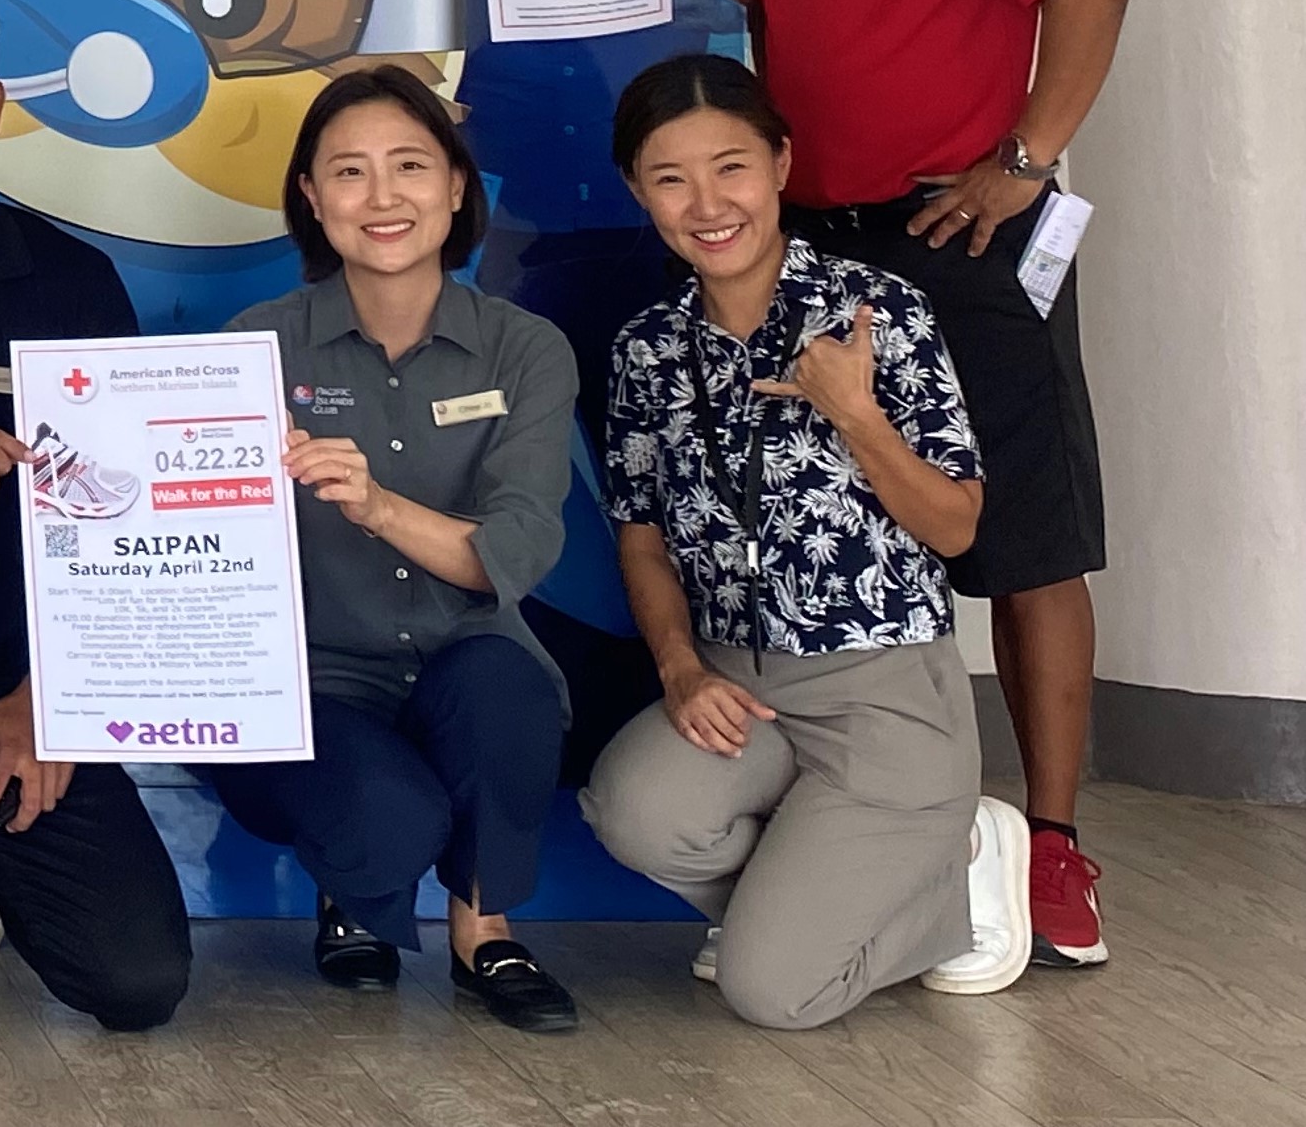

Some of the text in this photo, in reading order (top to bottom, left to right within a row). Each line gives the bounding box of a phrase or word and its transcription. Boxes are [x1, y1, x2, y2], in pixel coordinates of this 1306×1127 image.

[109, 364, 239, 379] American Red Cross
[154, 445, 264, 472] 04.22.23
[152, 484, 271, 503] Walk for the Red
[113, 534, 220, 556] SAIPAN
[68, 557, 253, 579] Saturday April 22nd
[137, 718, 238, 744] aetna
